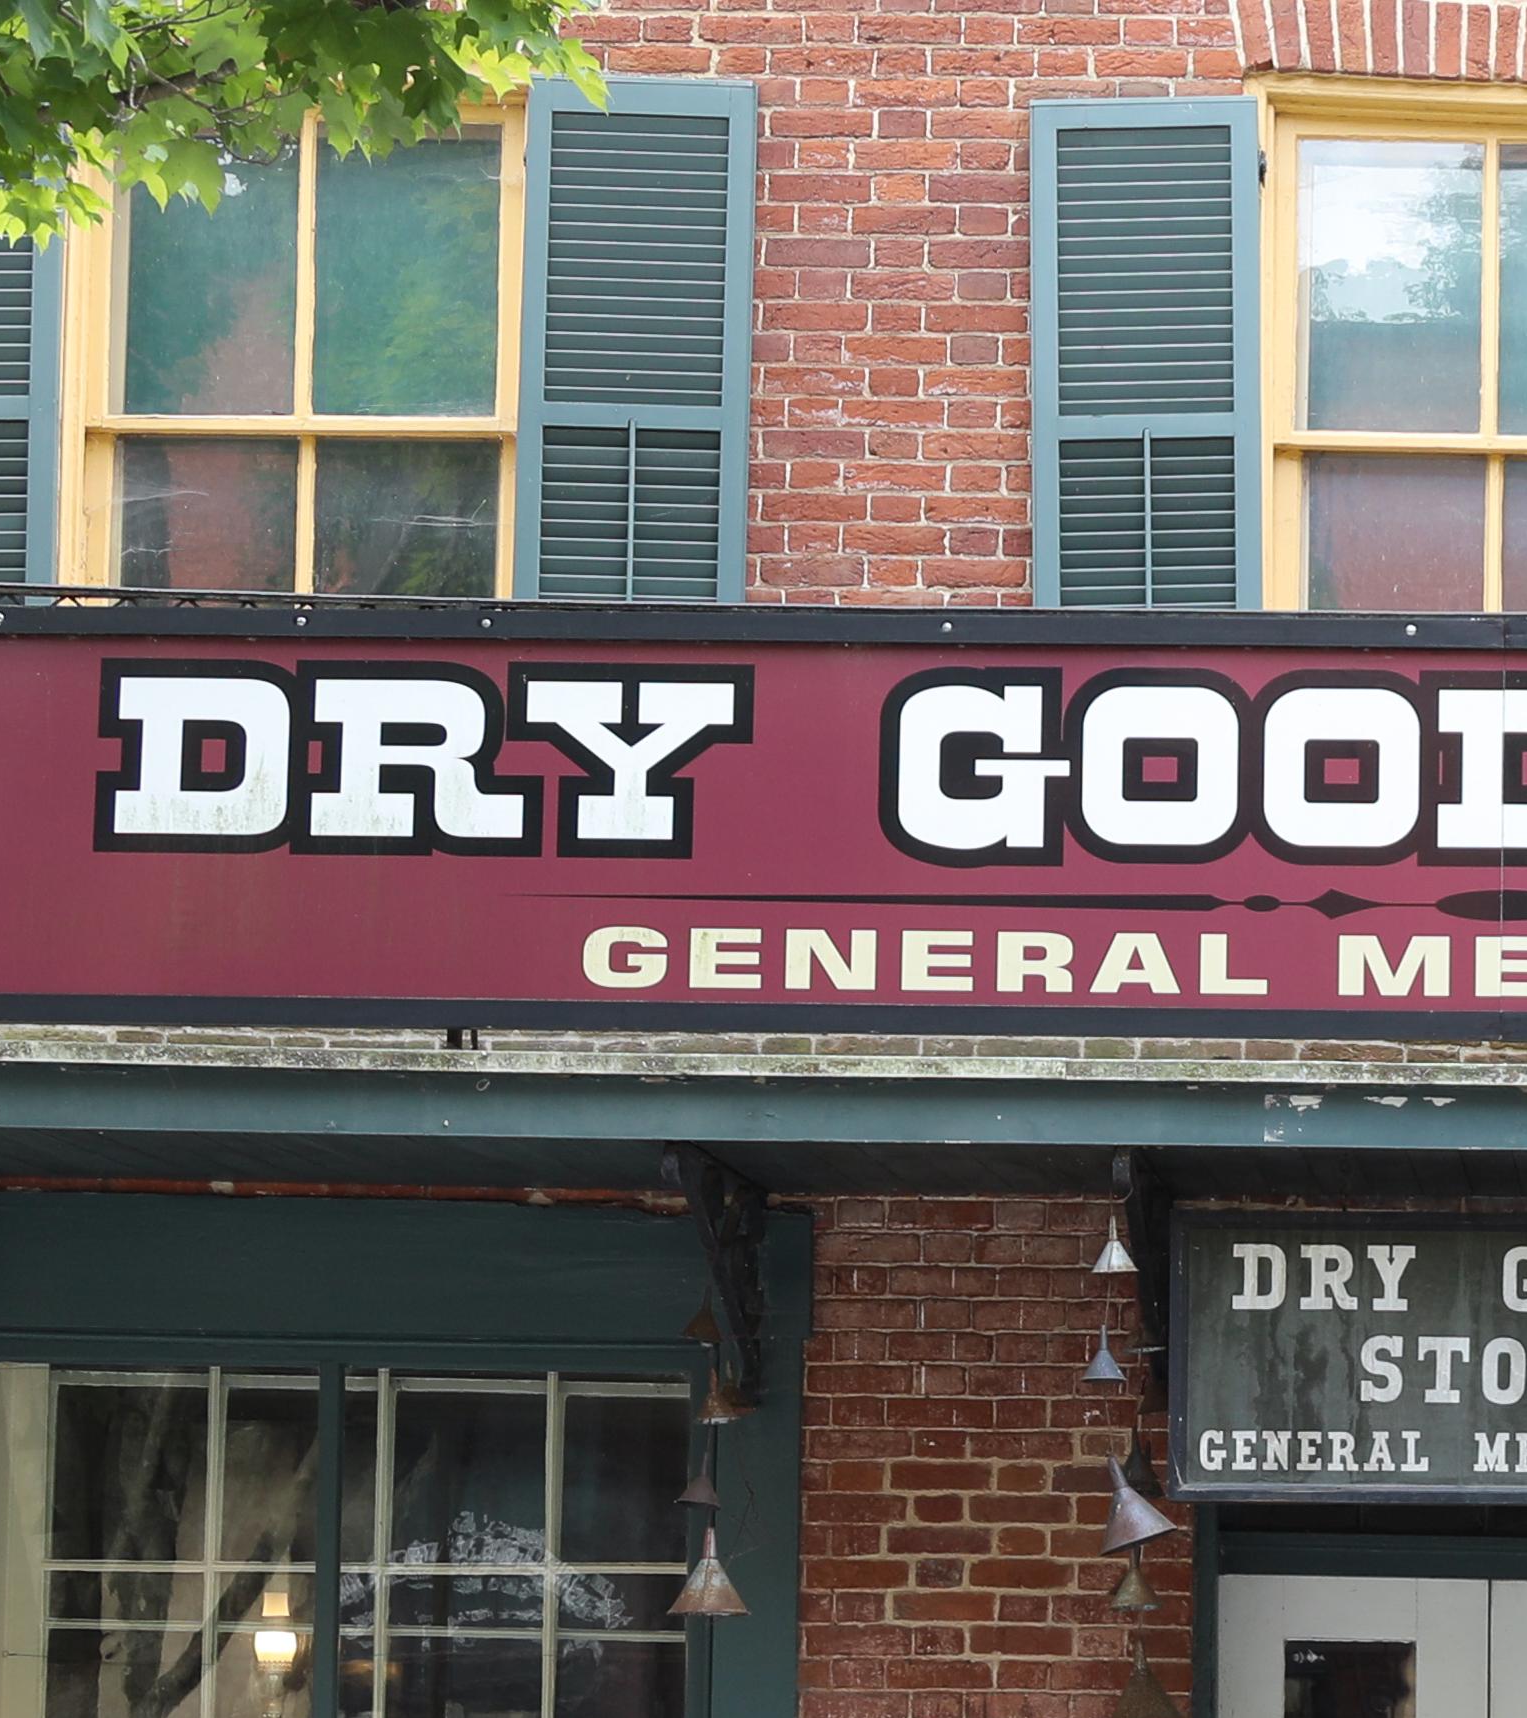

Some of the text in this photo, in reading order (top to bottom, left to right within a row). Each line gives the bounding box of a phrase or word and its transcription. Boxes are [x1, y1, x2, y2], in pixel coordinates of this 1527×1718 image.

[114, 678, 734, 840] DRY
[583, 926, 1268, 995] GENERAL
[1231, 1243, 1416, 1311] DRY
[1199, 1429, 1430, 1473] GENERAL
